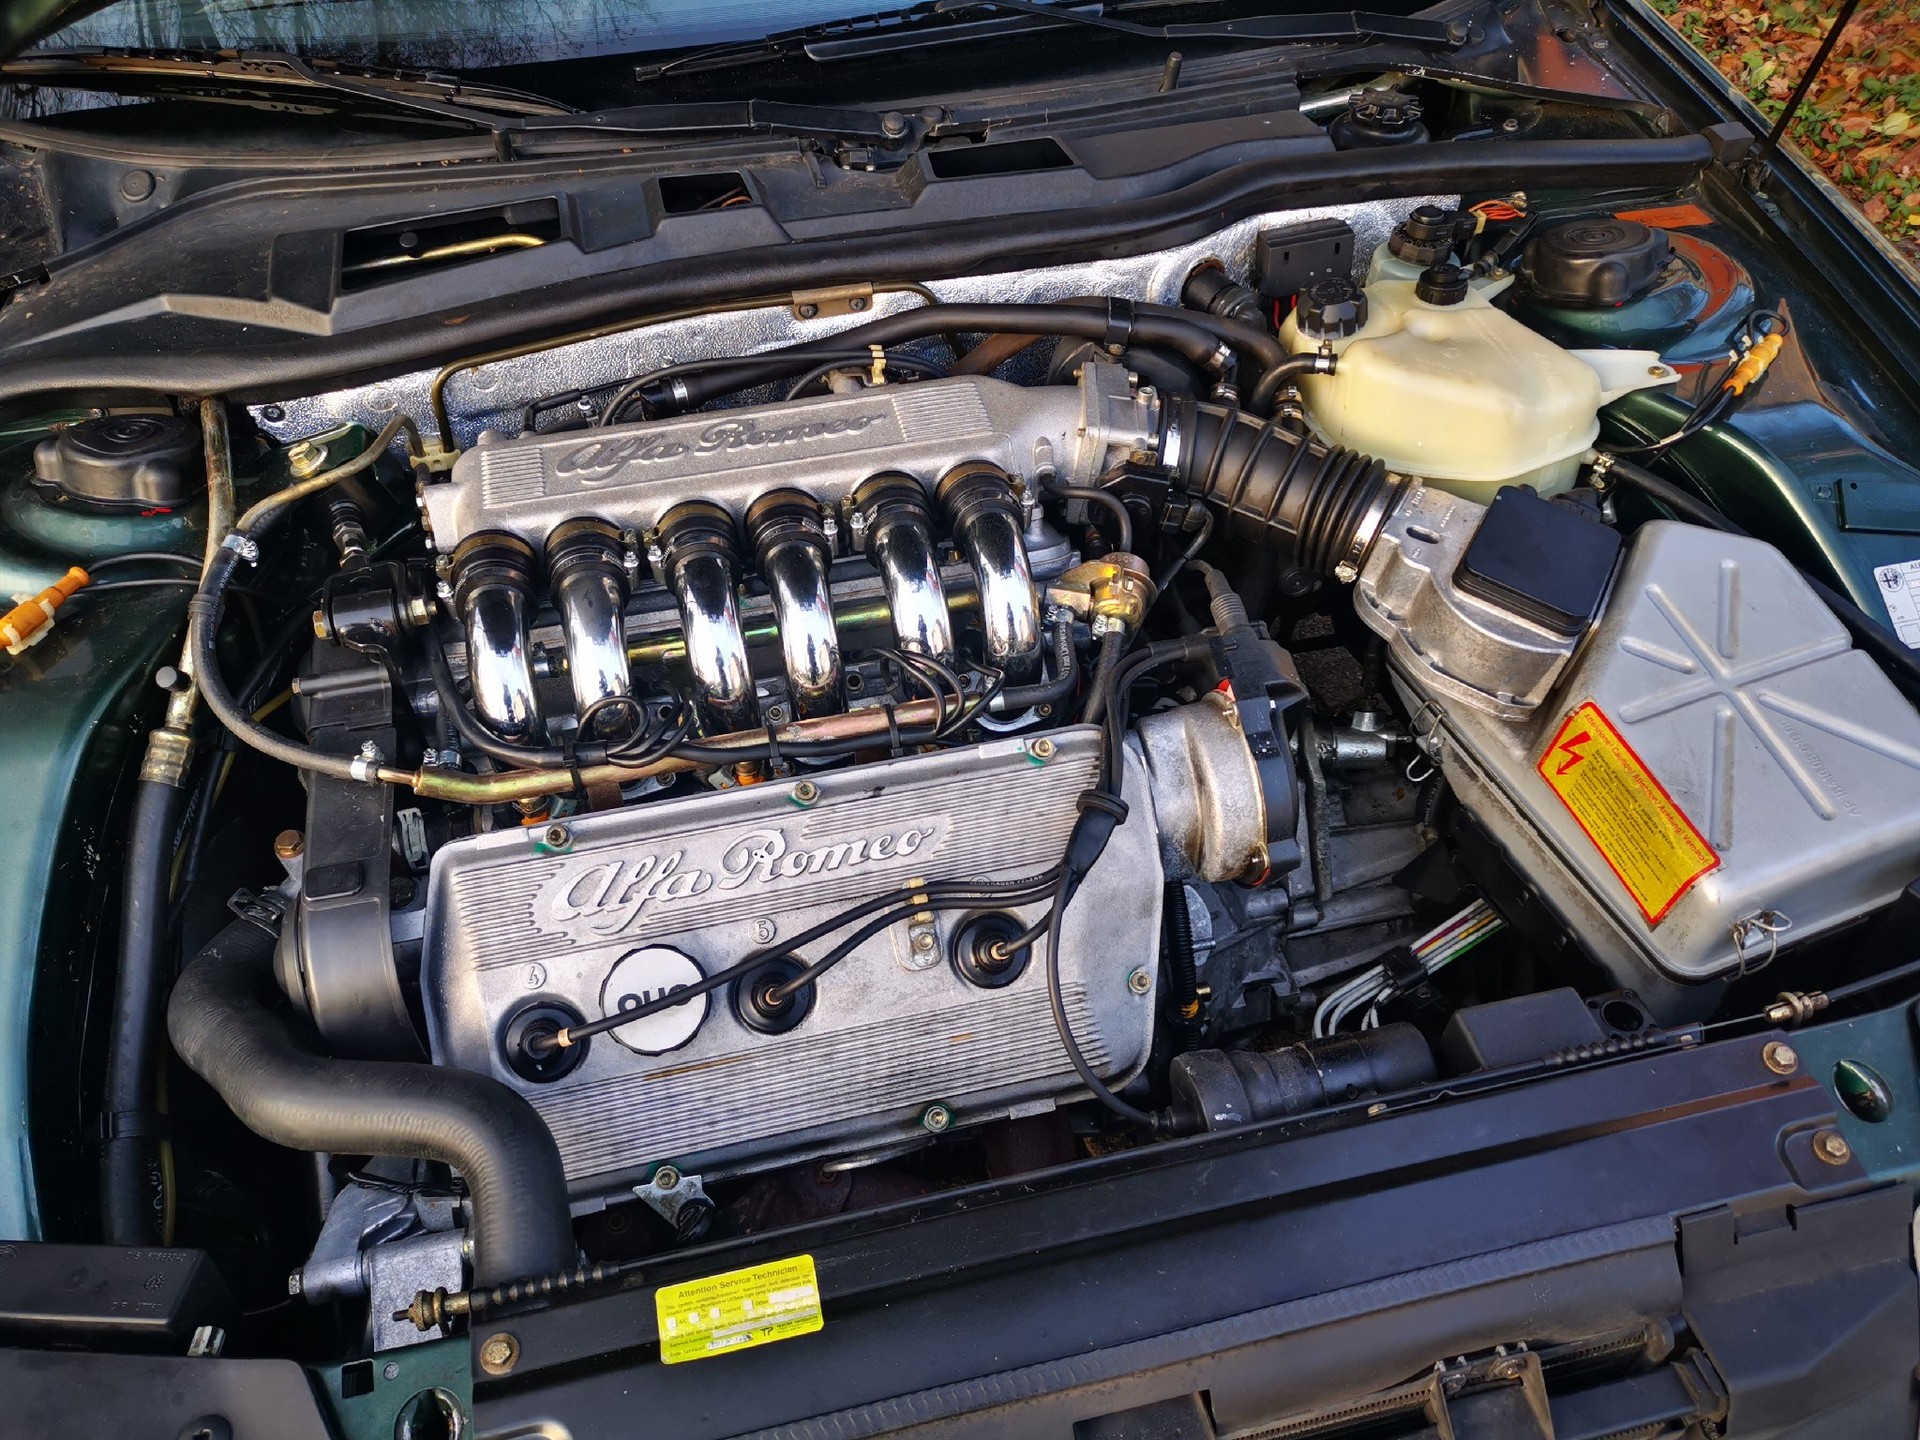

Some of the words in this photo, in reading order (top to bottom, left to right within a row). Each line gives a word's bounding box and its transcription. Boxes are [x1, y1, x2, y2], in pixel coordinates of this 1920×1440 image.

[556, 432, 692, 485] Alfa
[693, 413, 887, 458] Romeo
[1610, 746, 1636, 775] Caution!
[549, 847, 713, 937] Alfa
[714, 828, 933, 890] Romeo
[678, 1284, 717, 1298] Attention
[720, 1275, 751, 1289] Service
[752, 1265, 798, 1281] Technician
